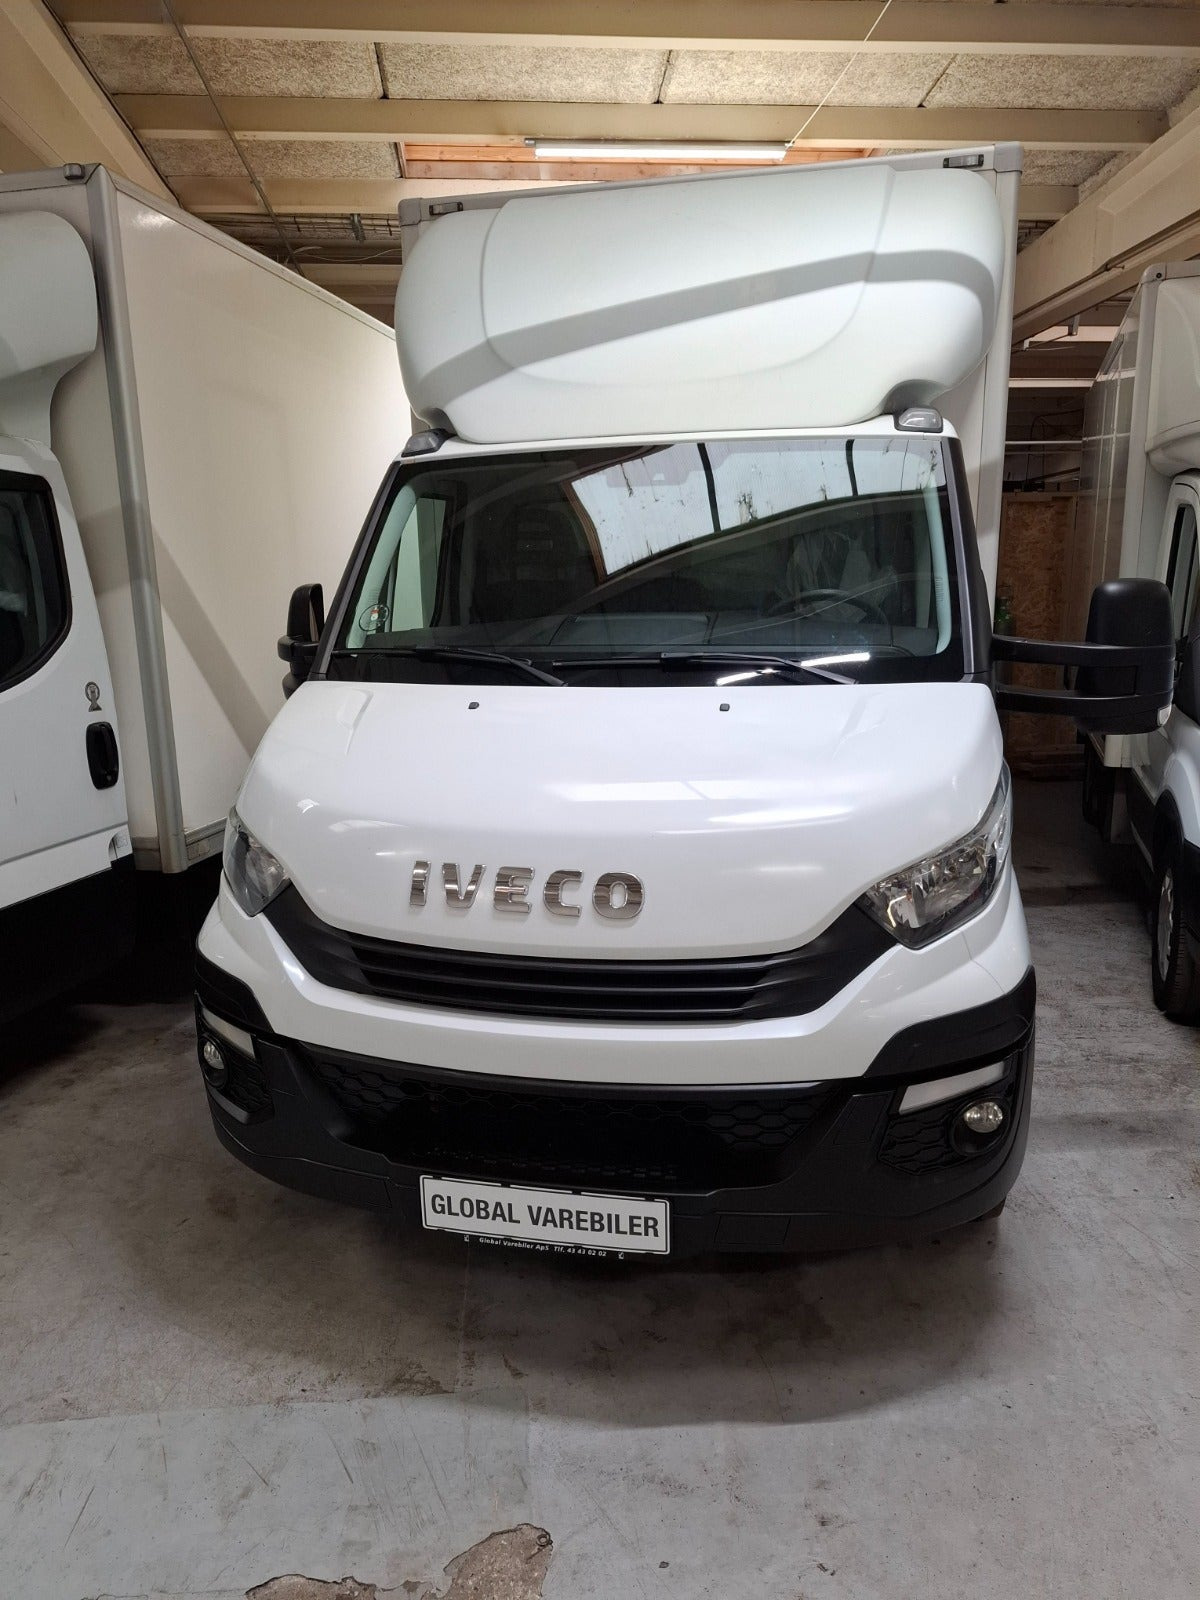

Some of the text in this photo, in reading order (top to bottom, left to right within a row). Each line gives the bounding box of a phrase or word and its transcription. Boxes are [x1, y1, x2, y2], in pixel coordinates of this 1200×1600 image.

[409, 860, 645, 919] IVECO
[431, 1194, 660, 1238] GLOBAL VAREBILER
[479, 1237, 501, 1245] Global
[503, 1240, 534, 1249] Varebiler
